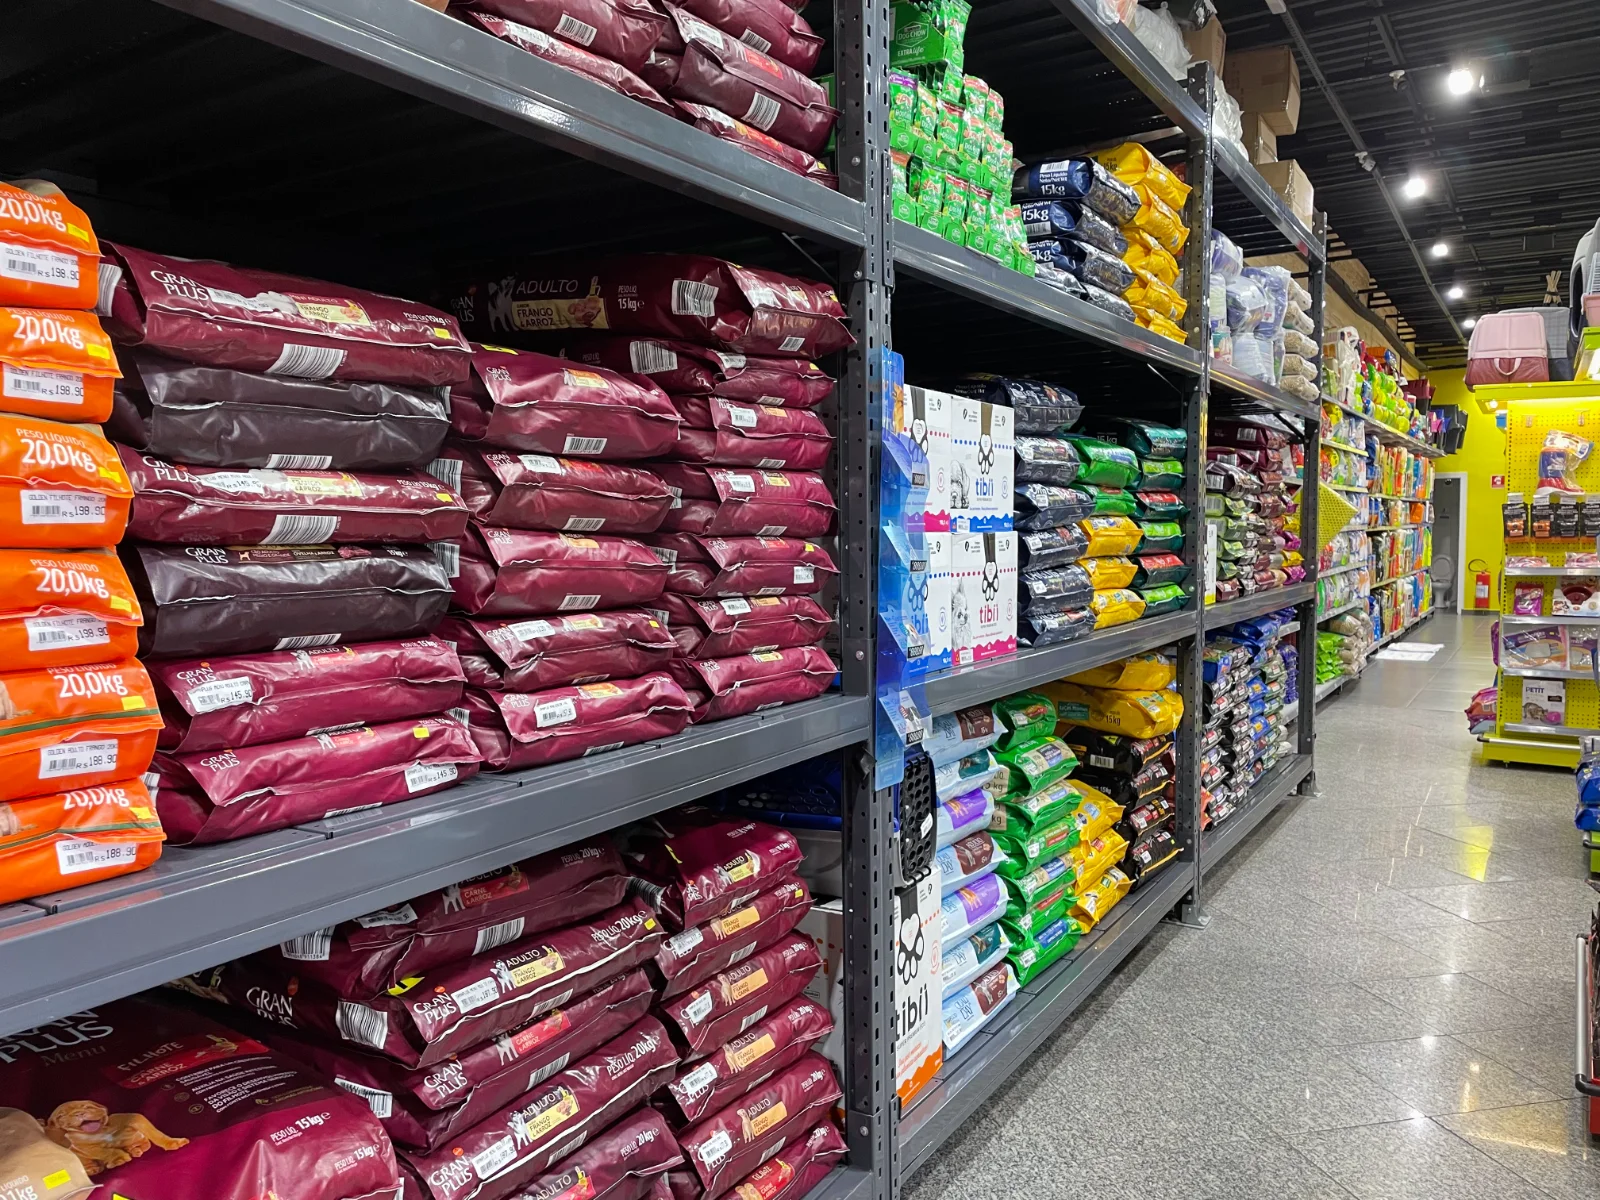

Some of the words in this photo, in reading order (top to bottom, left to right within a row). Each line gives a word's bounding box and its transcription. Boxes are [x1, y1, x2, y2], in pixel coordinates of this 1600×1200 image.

[1040, 183, 1066, 197] 15kg
[0, 196, 68, 233] 20,0kg
[1022, 207, 1049, 222] 15kg
[1030, 248, 1052, 261] 5kg
[163, 282, 210, 302] PLUS
[516, 278, 579, 294] ADULTO
[517, 306, 554, 319] FRANGO
[11, 313, 85, 350] 20,0kg
[16, 427, 43, 440] PESO
[46, 430, 87, 449] LÍQUIDO
[21, 437, 97, 473] 20,0kg
[153, 466, 202, 483] PLUS
[487, 529, 511, 539] GRAN
[185, 546, 227, 557] GRAN
[195, 554, 229, 564] PLUS
[30, 558, 57, 569] PESO
[58, 559, 99, 573] LÍQUIDO
[36, 566, 109, 599] 20,0kg
[308, 646, 340, 656] ADULTO
[176, 666, 214, 680] GRAN
[186, 672, 217, 687] PLUS
[53, 670, 129, 700] 20,0kg
[503, 693, 528, 703] GRAN
[511, 699, 531, 710] PLUS
[1105, 714, 1121, 726] 15kg
[200, 751, 237, 767] GRAN
[209, 757, 241, 773] PLUS
[61, 786, 130, 811] 20,0kg
[579, 845, 600, 859] 20kg
[722, 855, 746, 872] ADULTO
[463, 886, 488, 899] CARNE
[615, 912, 643, 932] 20kg
[505, 948, 541, 968] ADULTO
[727, 964, 752, 983] ADULTO
[245, 985, 294, 1018] GRAN
[413, 991, 453, 1014] GRAN
[424, 1002, 457, 1026] PLUS
[0, 1019, 115, 1065] PLUS
[731, 1031, 757, 1051] ADULTO
[40, 1043, 108, 1067] Menu
[116, 1040, 184, 1073] FILHOTE
[606, 1059, 624, 1077] PESO
[629, 1036, 657, 1059] 20kg
[130, 1061, 175, 1084] CARNE
[145, 1062, 188, 1083] ARROZ
[423, 1058, 464, 1090] GRAN
[435, 1070, 469, 1099] PLUS
[211, 1100, 224, 1110] DO
[522, 1092, 557, 1120] ADULTO
[746, 1096, 772, 1118] ADULTO
[529, 1114, 551, 1133] FRANGO
[269, 1130, 286, 1143] PESO
[635, 1129, 654, 1147] 20kg
[333, 1159, 348, 1171] PESO
[430, 1153, 471, 1187] GRAN
[440, 1166, 474, 1199] PLUS
[535, 1173, 573, 1200] ADULTO
